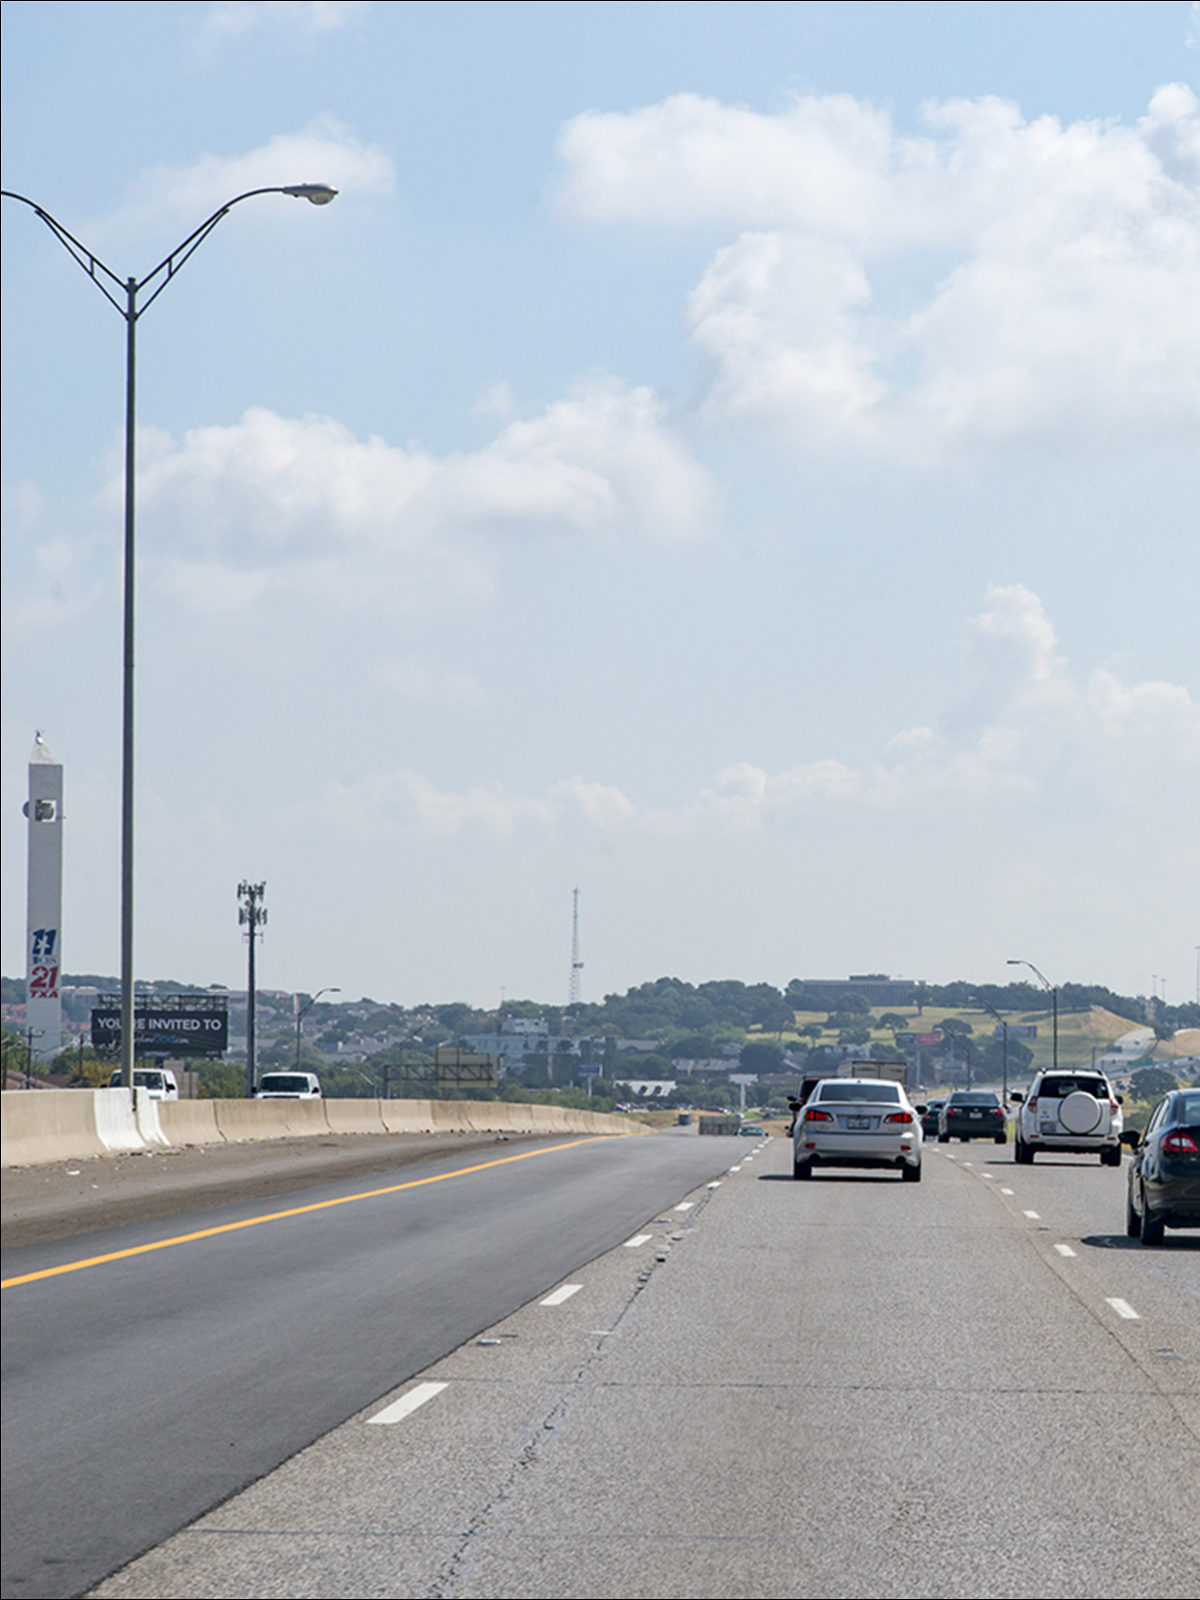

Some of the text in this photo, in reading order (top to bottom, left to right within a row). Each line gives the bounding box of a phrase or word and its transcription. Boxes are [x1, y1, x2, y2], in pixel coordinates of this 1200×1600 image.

[32, 928, 57, 955] 11
[30, 965, 59, 989] 21
[30, 989, 59, 998] TXA
[97, 1017, 222, 1031] YOUE INVITED TO
